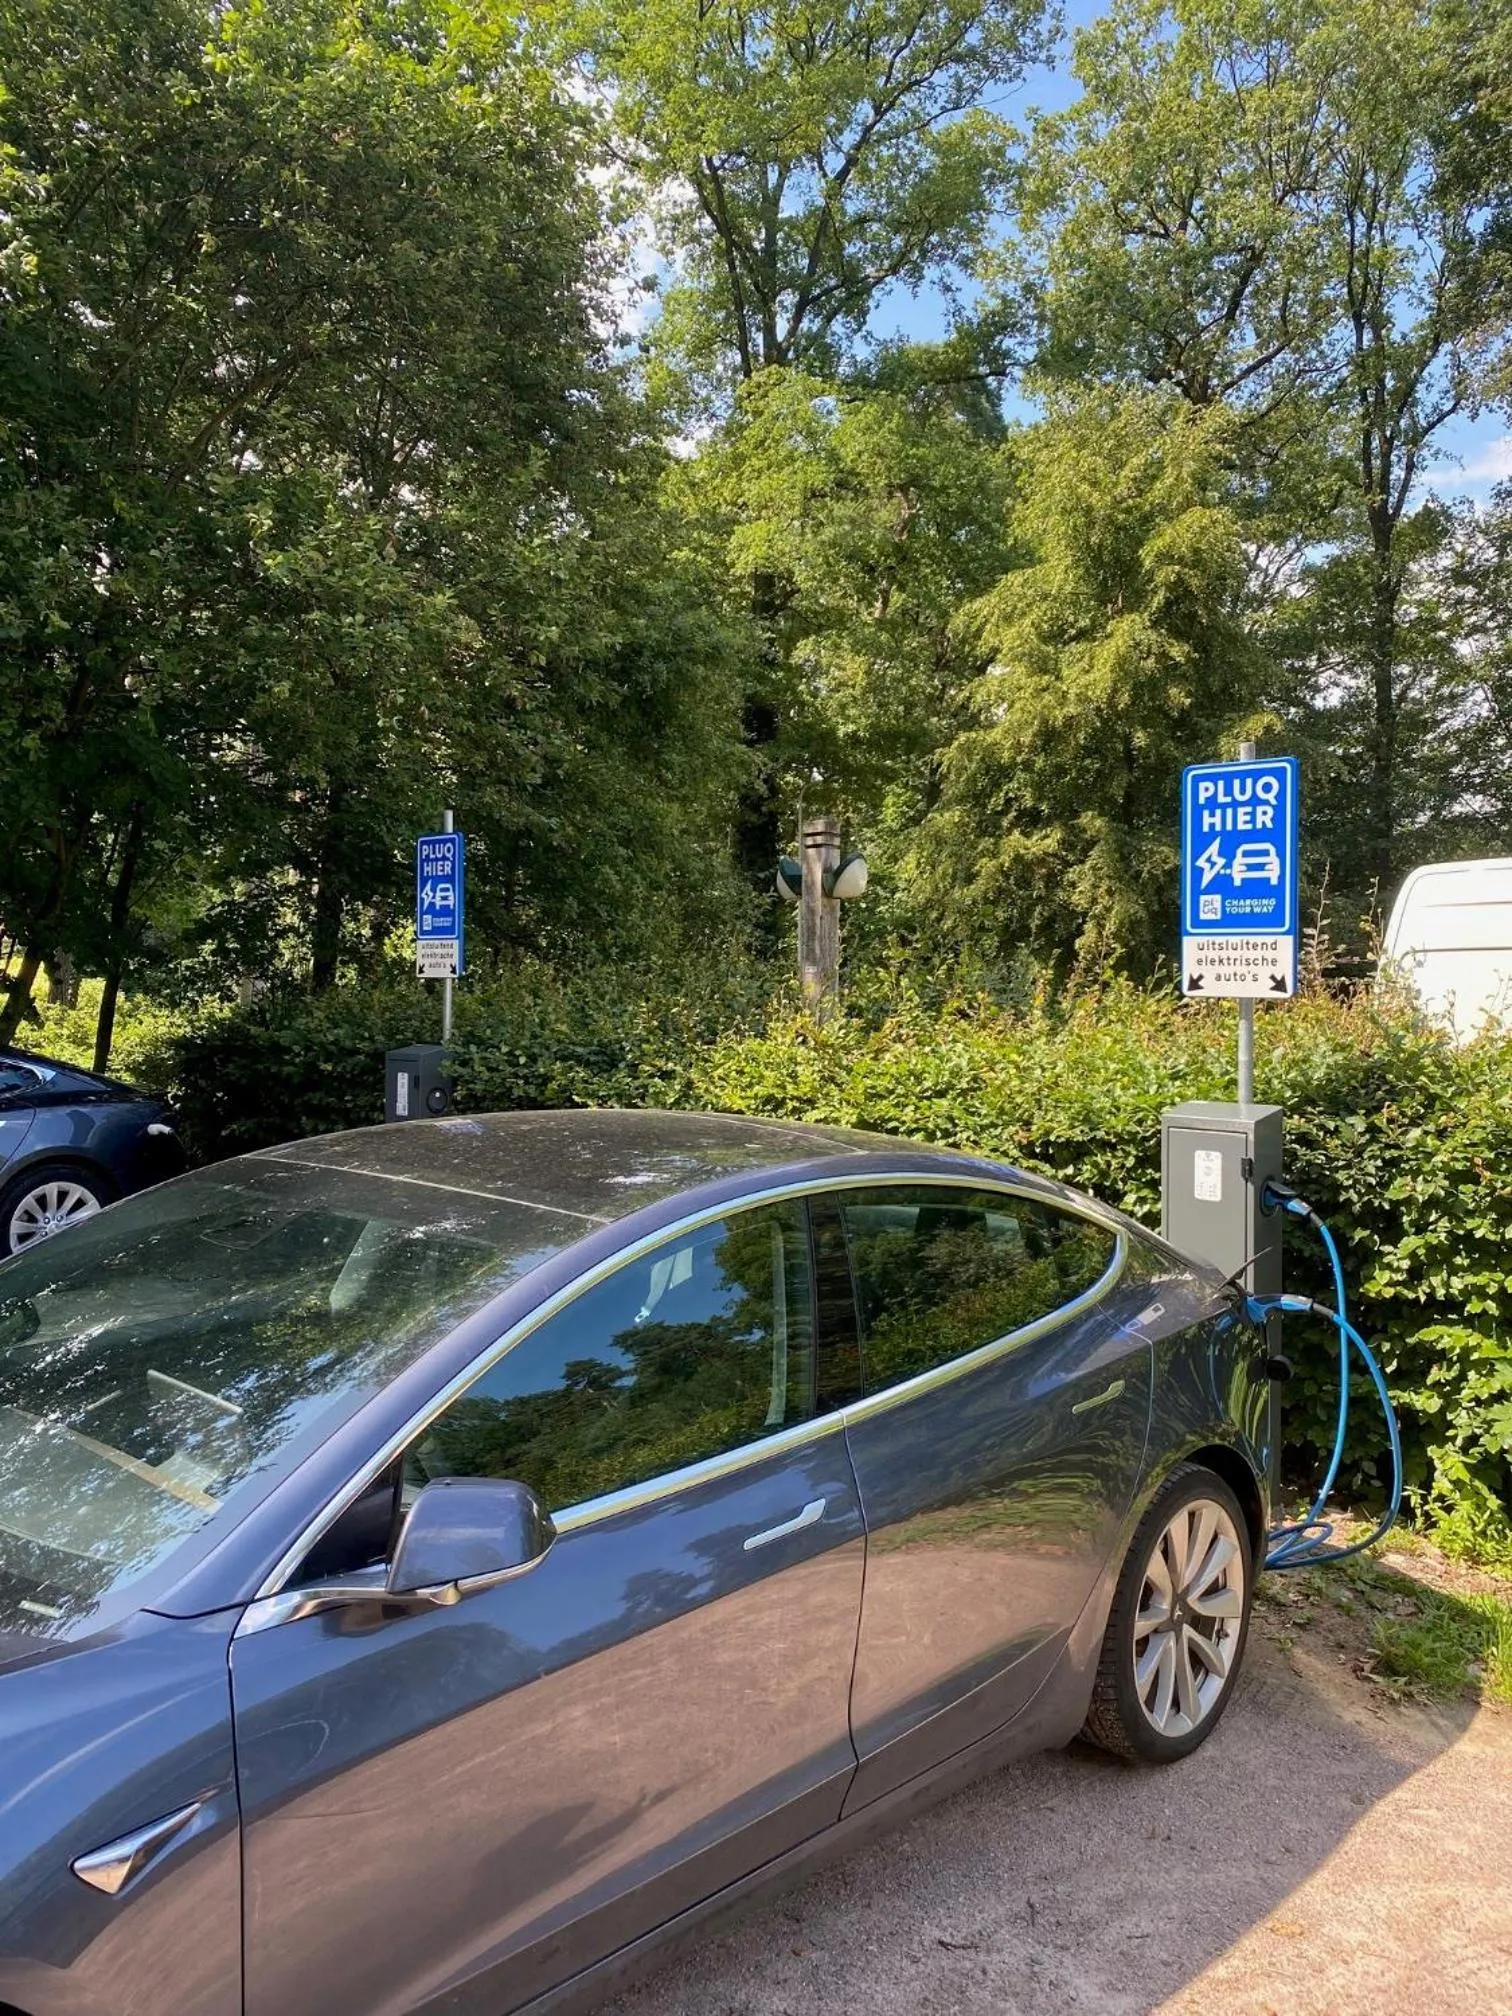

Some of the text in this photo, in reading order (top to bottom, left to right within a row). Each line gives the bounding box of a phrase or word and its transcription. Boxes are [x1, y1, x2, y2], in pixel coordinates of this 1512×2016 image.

[1198, 776, 1279, 805] PLUQ
[1202, 805, 1274, 832] HIER
[422, 843, 454, 861] PLUQ
[423, 861, 452, 876] HIER
[1225, 898, 1276, 907] CHARGING
[1225, 905, 1274, 914] YOUR WAY
[1197, 939, 1278, 951] uitsluitend
[1196, 955, 1278, 967] elektrische
[1215, 971, 1259, 982] auto's
